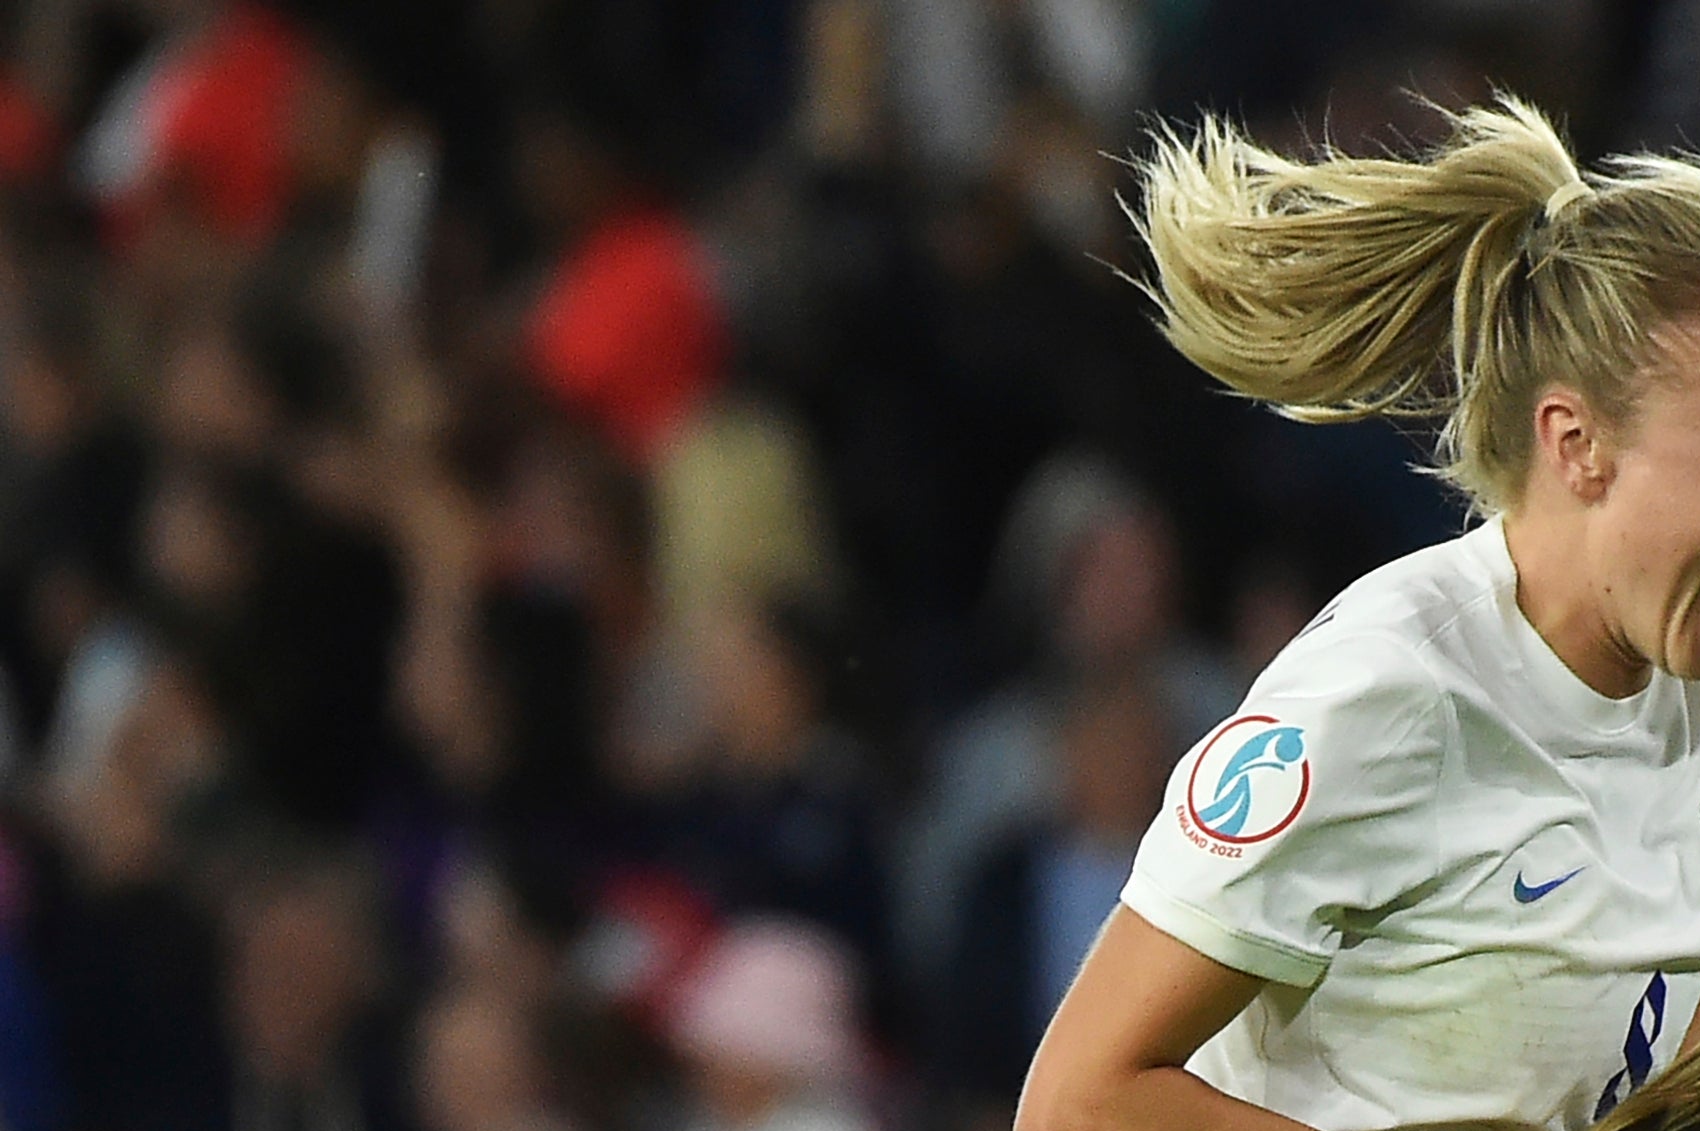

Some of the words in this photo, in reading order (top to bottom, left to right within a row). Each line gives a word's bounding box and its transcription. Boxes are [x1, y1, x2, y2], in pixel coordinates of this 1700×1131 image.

[1176, 805, 1208, 848] ENGLAND
[1210, 843, 1243, 858] 2022
[1593, 970, 1667, 1121] 8
